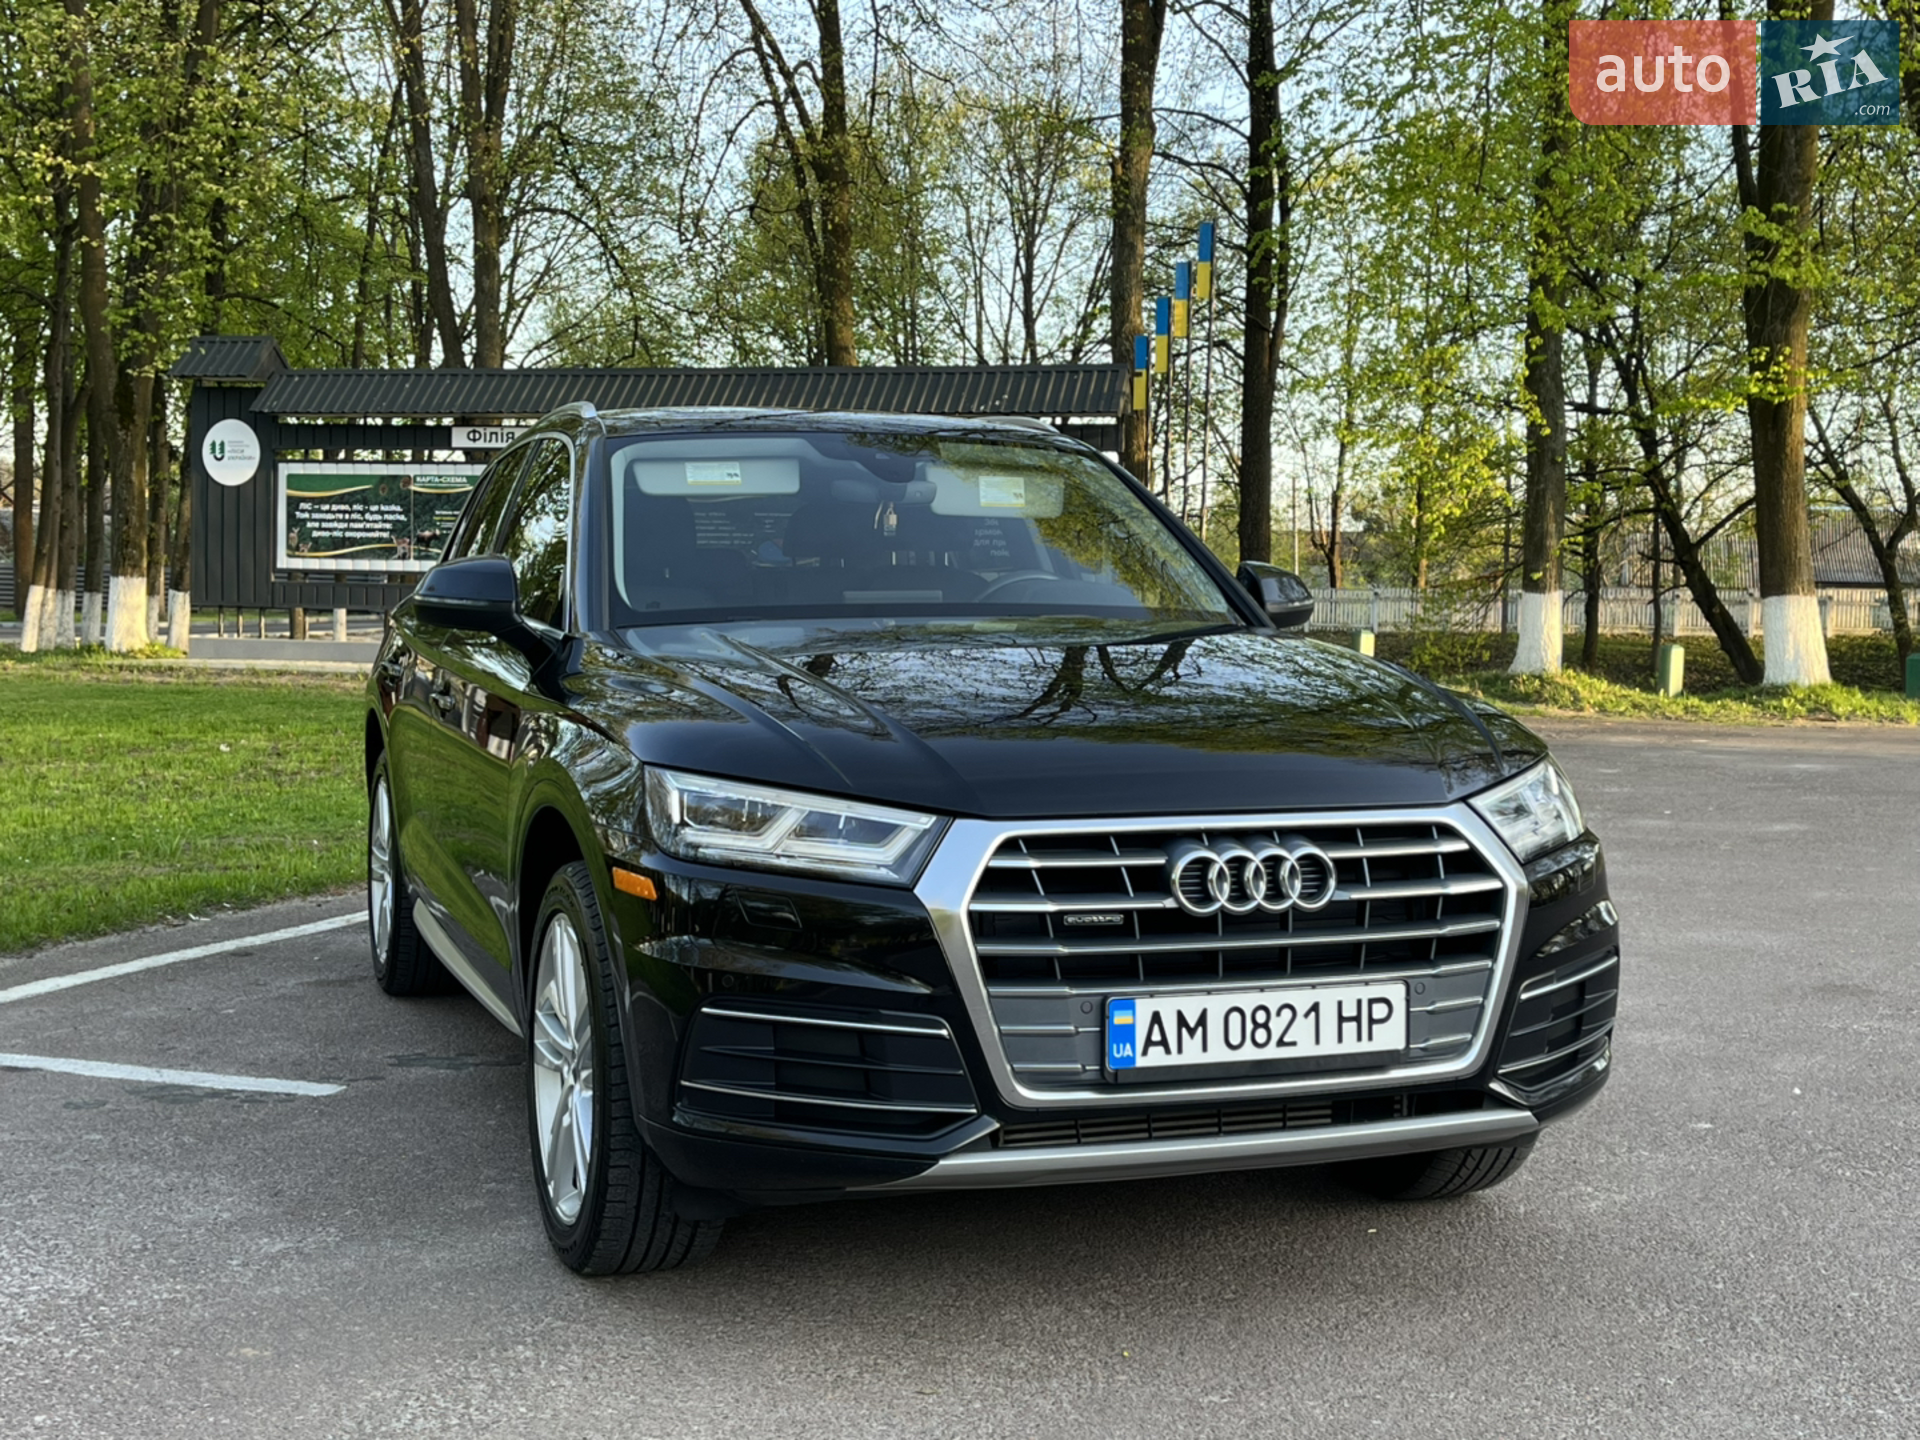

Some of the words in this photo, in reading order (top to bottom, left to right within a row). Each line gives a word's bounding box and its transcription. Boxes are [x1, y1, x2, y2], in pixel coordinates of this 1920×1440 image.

[466, 427, 515, 444] Філія
[1067, 915, 1121, 924] quattro
[1141, 1007, 1208, 1057] AM
[1223, 1002, 1320, 1051] 0821
[1337, 996, 1394, 1044] HP
[1113, 1043, 1133, 1058] UA
